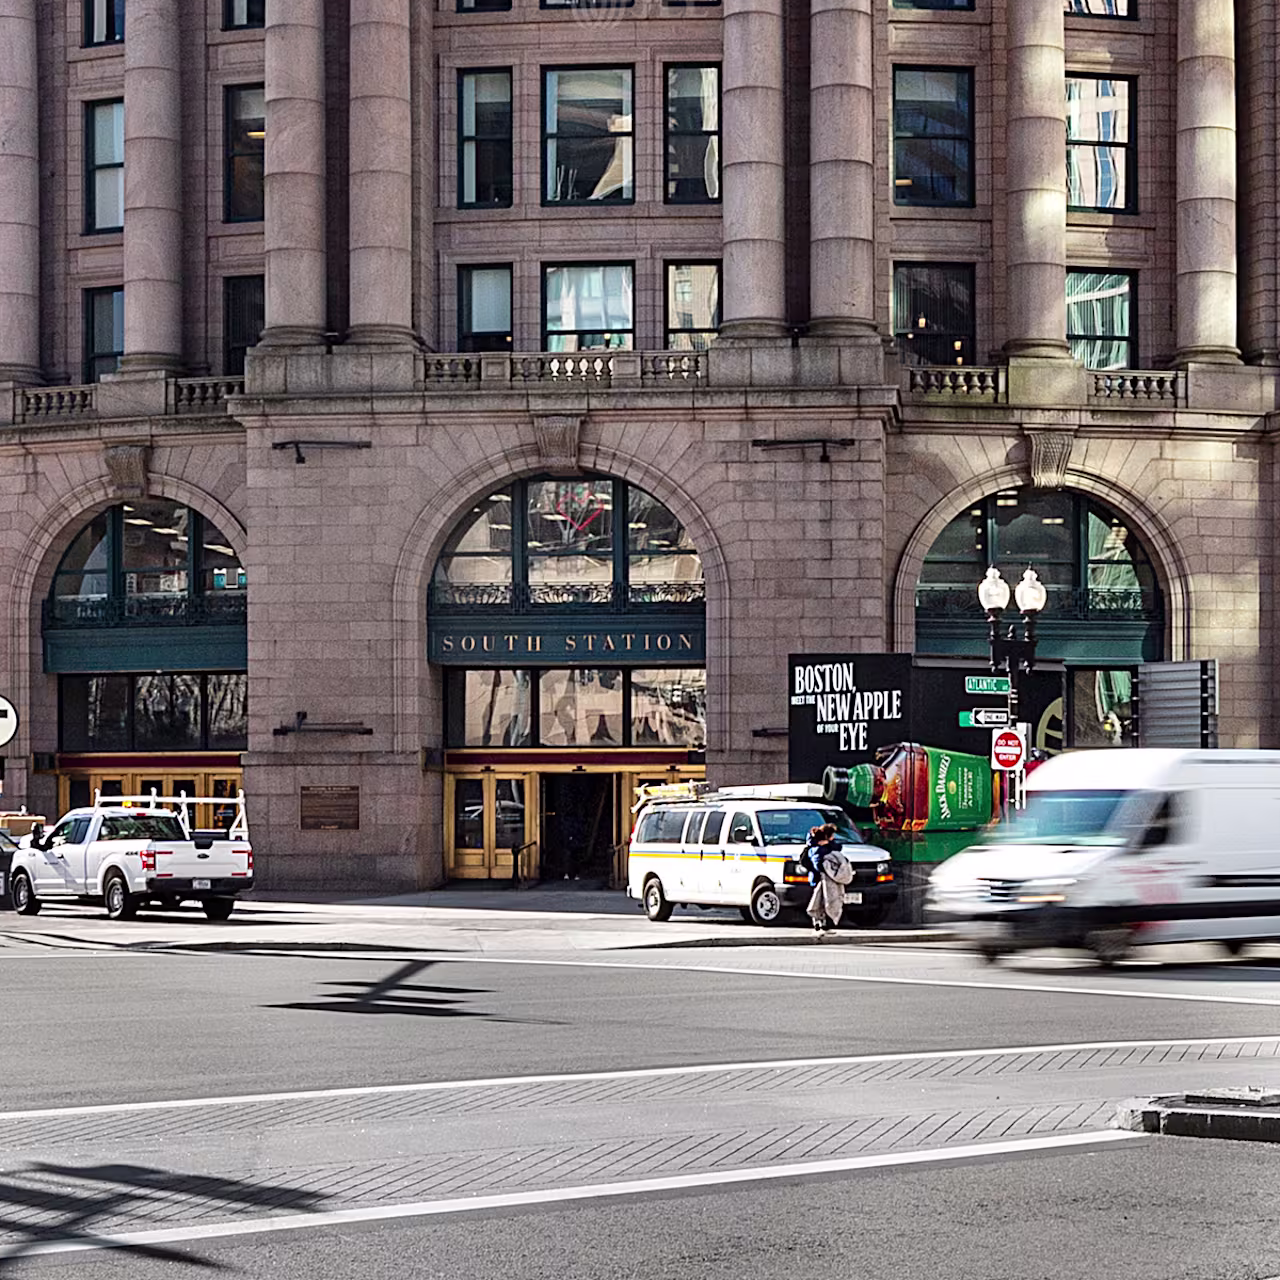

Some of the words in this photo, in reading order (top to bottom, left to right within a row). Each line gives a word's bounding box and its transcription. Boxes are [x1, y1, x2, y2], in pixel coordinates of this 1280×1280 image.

[442, 634, 541, 652] SOUTH
[565, 633, 693, 651] STATION
[794, 662, 857, 694] BOSTON,
[968, 679, 997, 691] ATLANTIC
[805, 695, 816, 705] THE
[816, 692, 851, 722] NEW
[853, 690, 902, 721] APPLE
[984, 713, 993, 721] ONE
[816, 723, 825, 733] OF
[825, 723, 839, 733] YOUR
[840, 722, 869, 751] EYE
[937, 793, 951, 820] JACK
